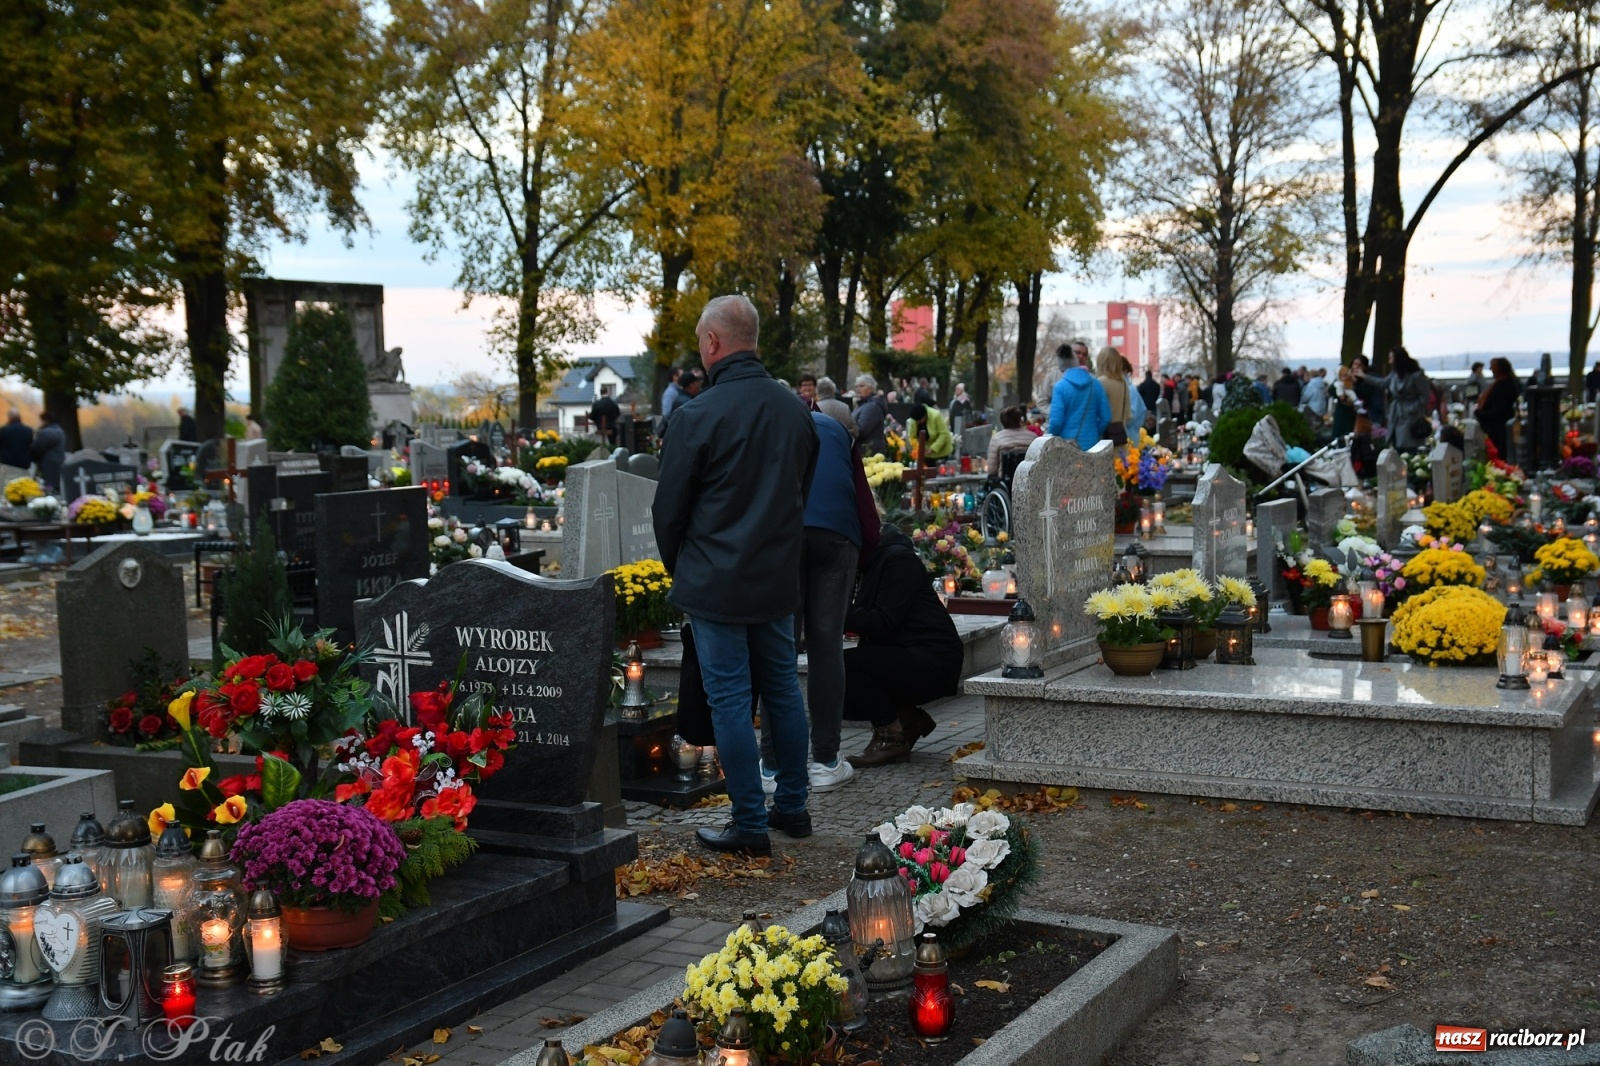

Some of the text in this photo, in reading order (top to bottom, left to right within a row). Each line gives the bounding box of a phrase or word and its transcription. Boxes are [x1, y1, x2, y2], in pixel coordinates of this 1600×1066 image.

[1067, 494, 1104, 513] GLOMBIK
[1075, 517, 1097, 534] ALOIS
[361, 551, 399, 568] JÓZEF
[1074, 556, 1098, 572] MARIA
[454, 626, 554, 652] WYROBEK
[474, 655, 539, 677] ALOJZY
[491, 705, 537, 724] NATA
[546, 733, 571, 747] 2014
